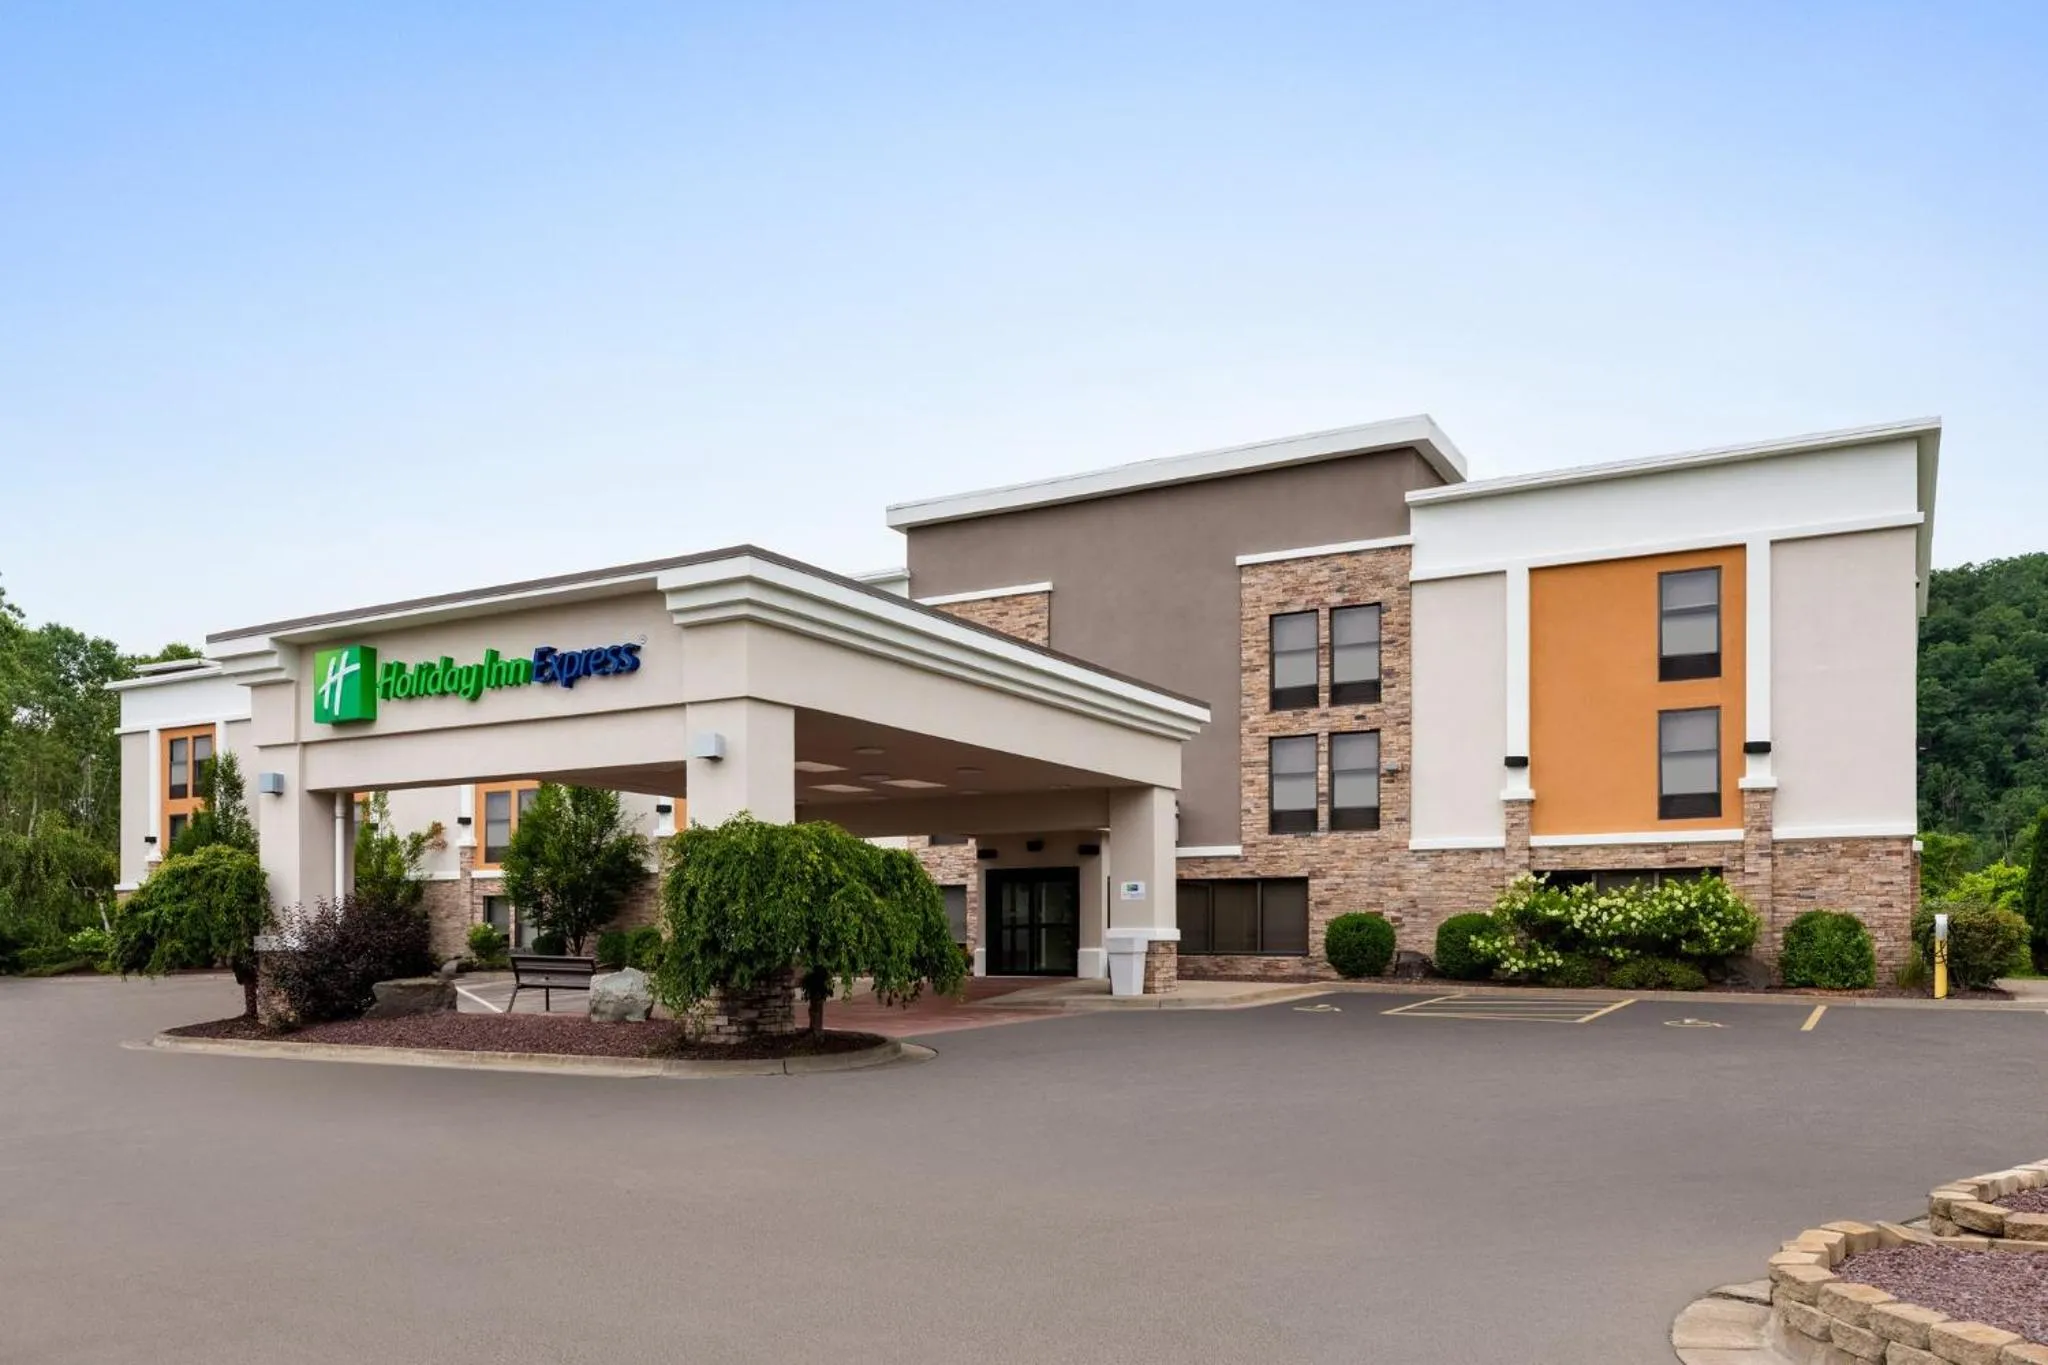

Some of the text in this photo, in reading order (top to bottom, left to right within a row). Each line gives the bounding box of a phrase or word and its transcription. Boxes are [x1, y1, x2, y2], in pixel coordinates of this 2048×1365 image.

[378, 642, 642, 701] Holiday Inn Express
